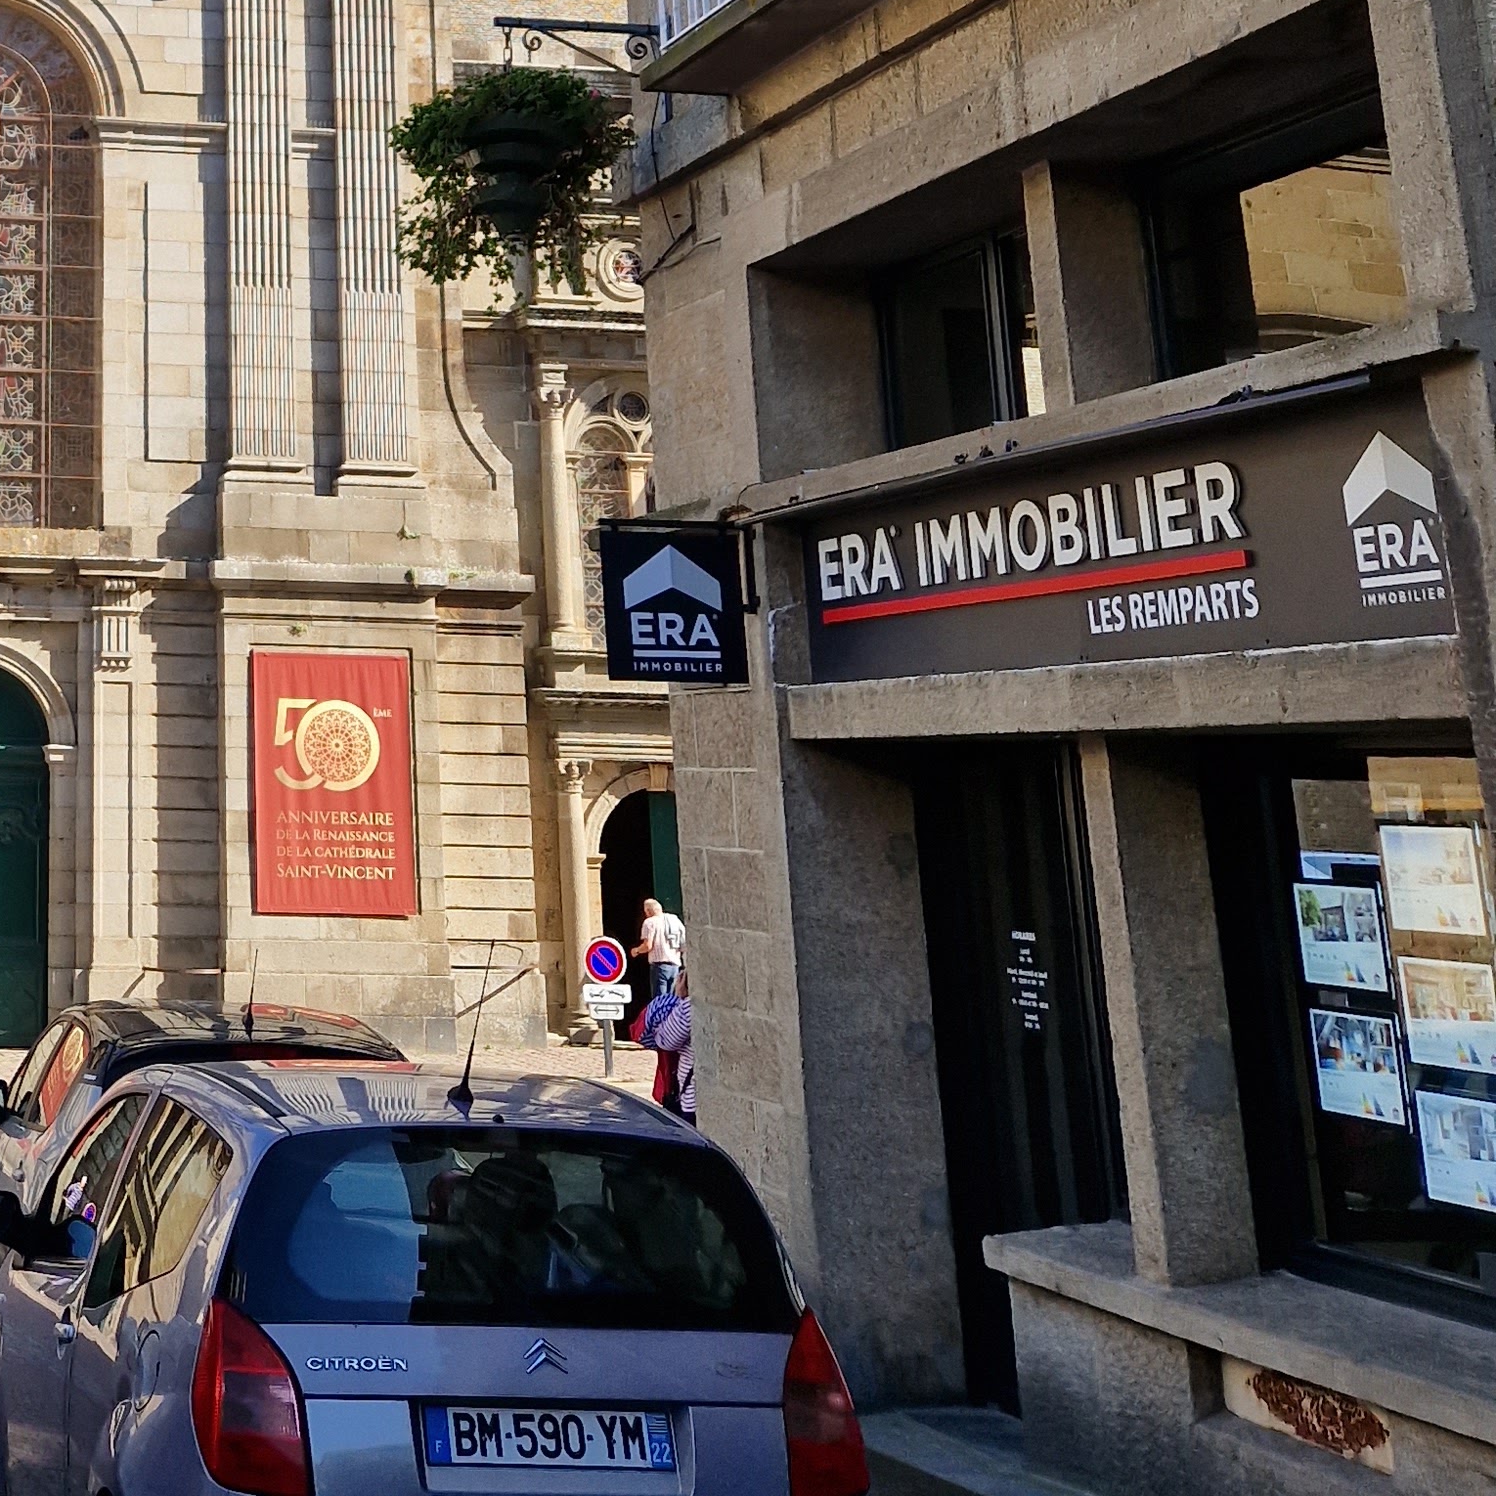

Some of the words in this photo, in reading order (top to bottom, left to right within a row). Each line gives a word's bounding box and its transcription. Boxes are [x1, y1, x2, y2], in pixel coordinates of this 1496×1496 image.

[817, 526, 902, 602] ERA
[915, 461, 1246, 587] IMMOBILIER
[1353, 518, 1440, 573] ERA
[1086, 595, 1127, 635] LES
[1130, 578, 1260, 630] REMPARTS
[1361, 587, 1447, 607] IMMOBILIER
[630, 611, 720, 647] ERA
[633, 661, 723, 673] IMMOBILIER
[274, 698, 381, 792] 50
[276, 810, 395, 826] ANNIVERSAIRE
[276, 829, 292, 840] DE
[295, 829, 310, 841] LA
[313, 829, 395, 842] RENAISSANCE
[276, 846, 293, 857] DE
[296, 846, 312, 858] LA
[314, 844, 396, 859] CATHÉDRALE
[276, 863, 396, 880] SAINT-VINCENT
[305, 1354, 408, 1372] CITROËN
[434, 1440, 442, 1453] F
[651, 1442, 673, 1463] 22
